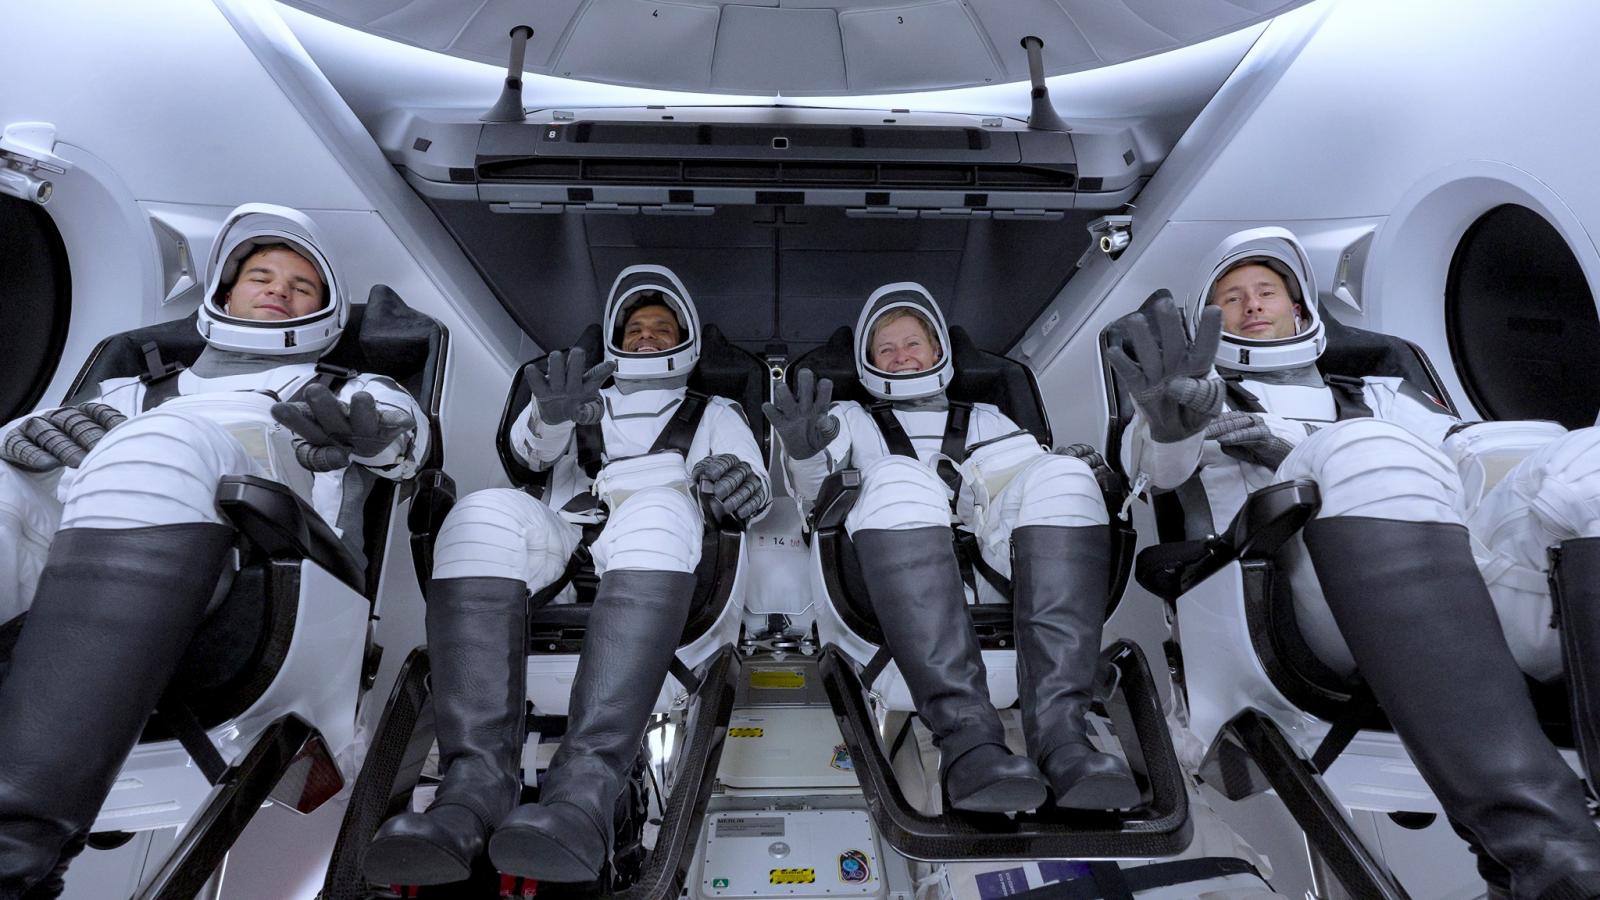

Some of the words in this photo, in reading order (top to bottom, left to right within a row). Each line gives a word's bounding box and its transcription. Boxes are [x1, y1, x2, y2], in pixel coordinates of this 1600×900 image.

[652, 9, 658, 17] 4
[897, 16, 904, 25] 3
[549, 130, 556, 138] 8
[773, 537, 785, 546] 14
